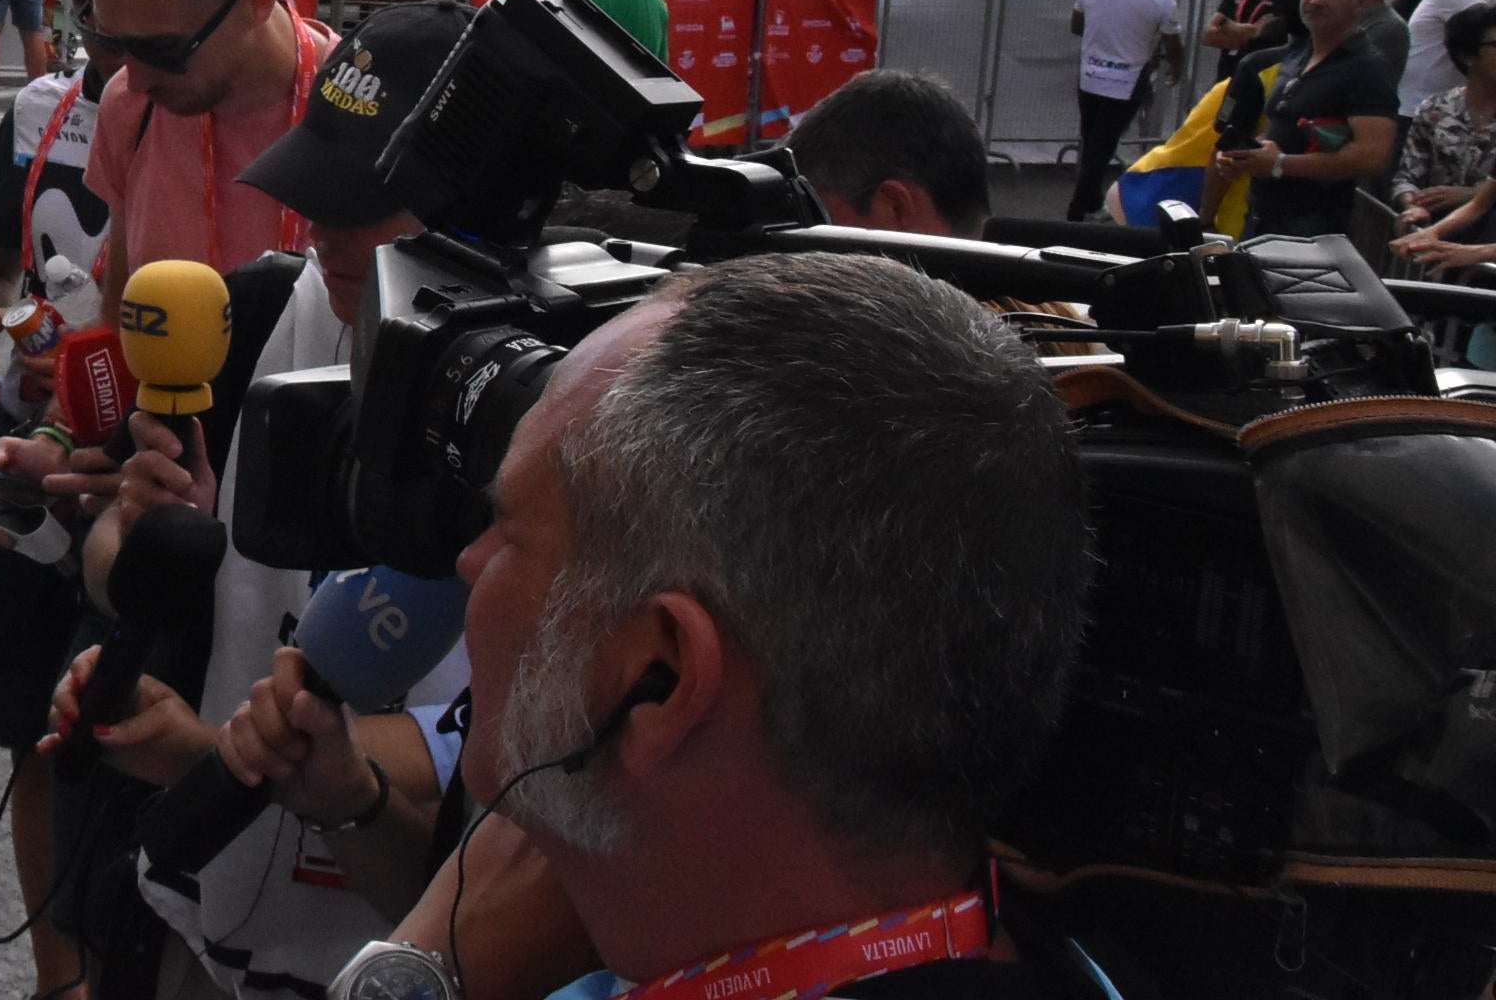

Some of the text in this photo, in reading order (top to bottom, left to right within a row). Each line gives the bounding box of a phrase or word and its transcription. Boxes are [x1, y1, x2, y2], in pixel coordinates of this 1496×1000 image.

[310, 77, 380, 117] YARDAS
[332, 62, 381, 102] 100
[430, 79, 457, 122] SWIT
[92, 356, 117, 424] LA VUELTA
[862, 931, 933, 962] LA VUELTA
